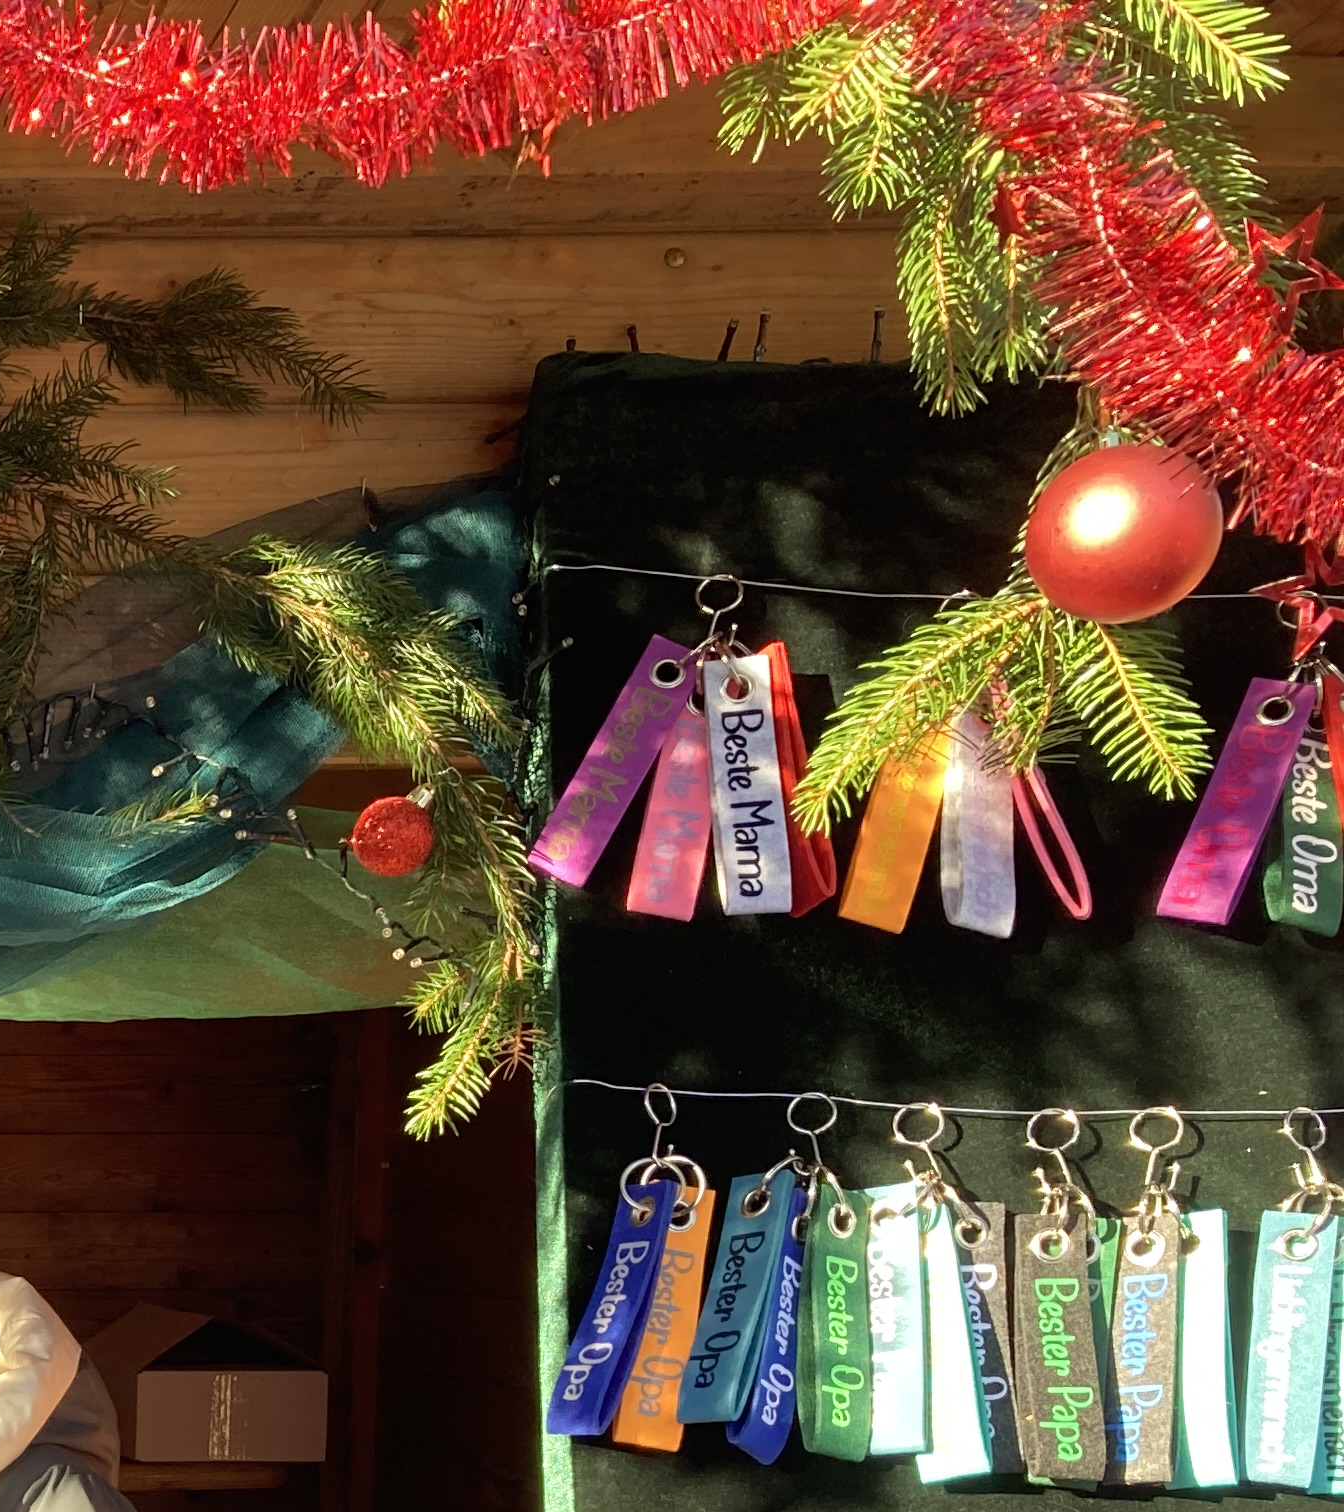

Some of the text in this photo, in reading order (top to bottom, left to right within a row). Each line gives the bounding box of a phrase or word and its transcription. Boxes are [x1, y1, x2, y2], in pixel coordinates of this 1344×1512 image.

[720, 708, 775, 898] Beste Mama
[1291, 736, 1338, 915] Beste Oma
[562, 1240, 650, 1402] Bester Opa
[638, 1248, 695, 1418] Bester Opa
[690, 1230, 766, 1390] Bester Opa
[759, 1255, 803, 1427] Bester Opa
[821, 1255, 865, 1429] Bester Opa
[1034, 1277, 1094, 1462] Bester Papa
[1106, 1273, 1168, 1463] Bester Papa
